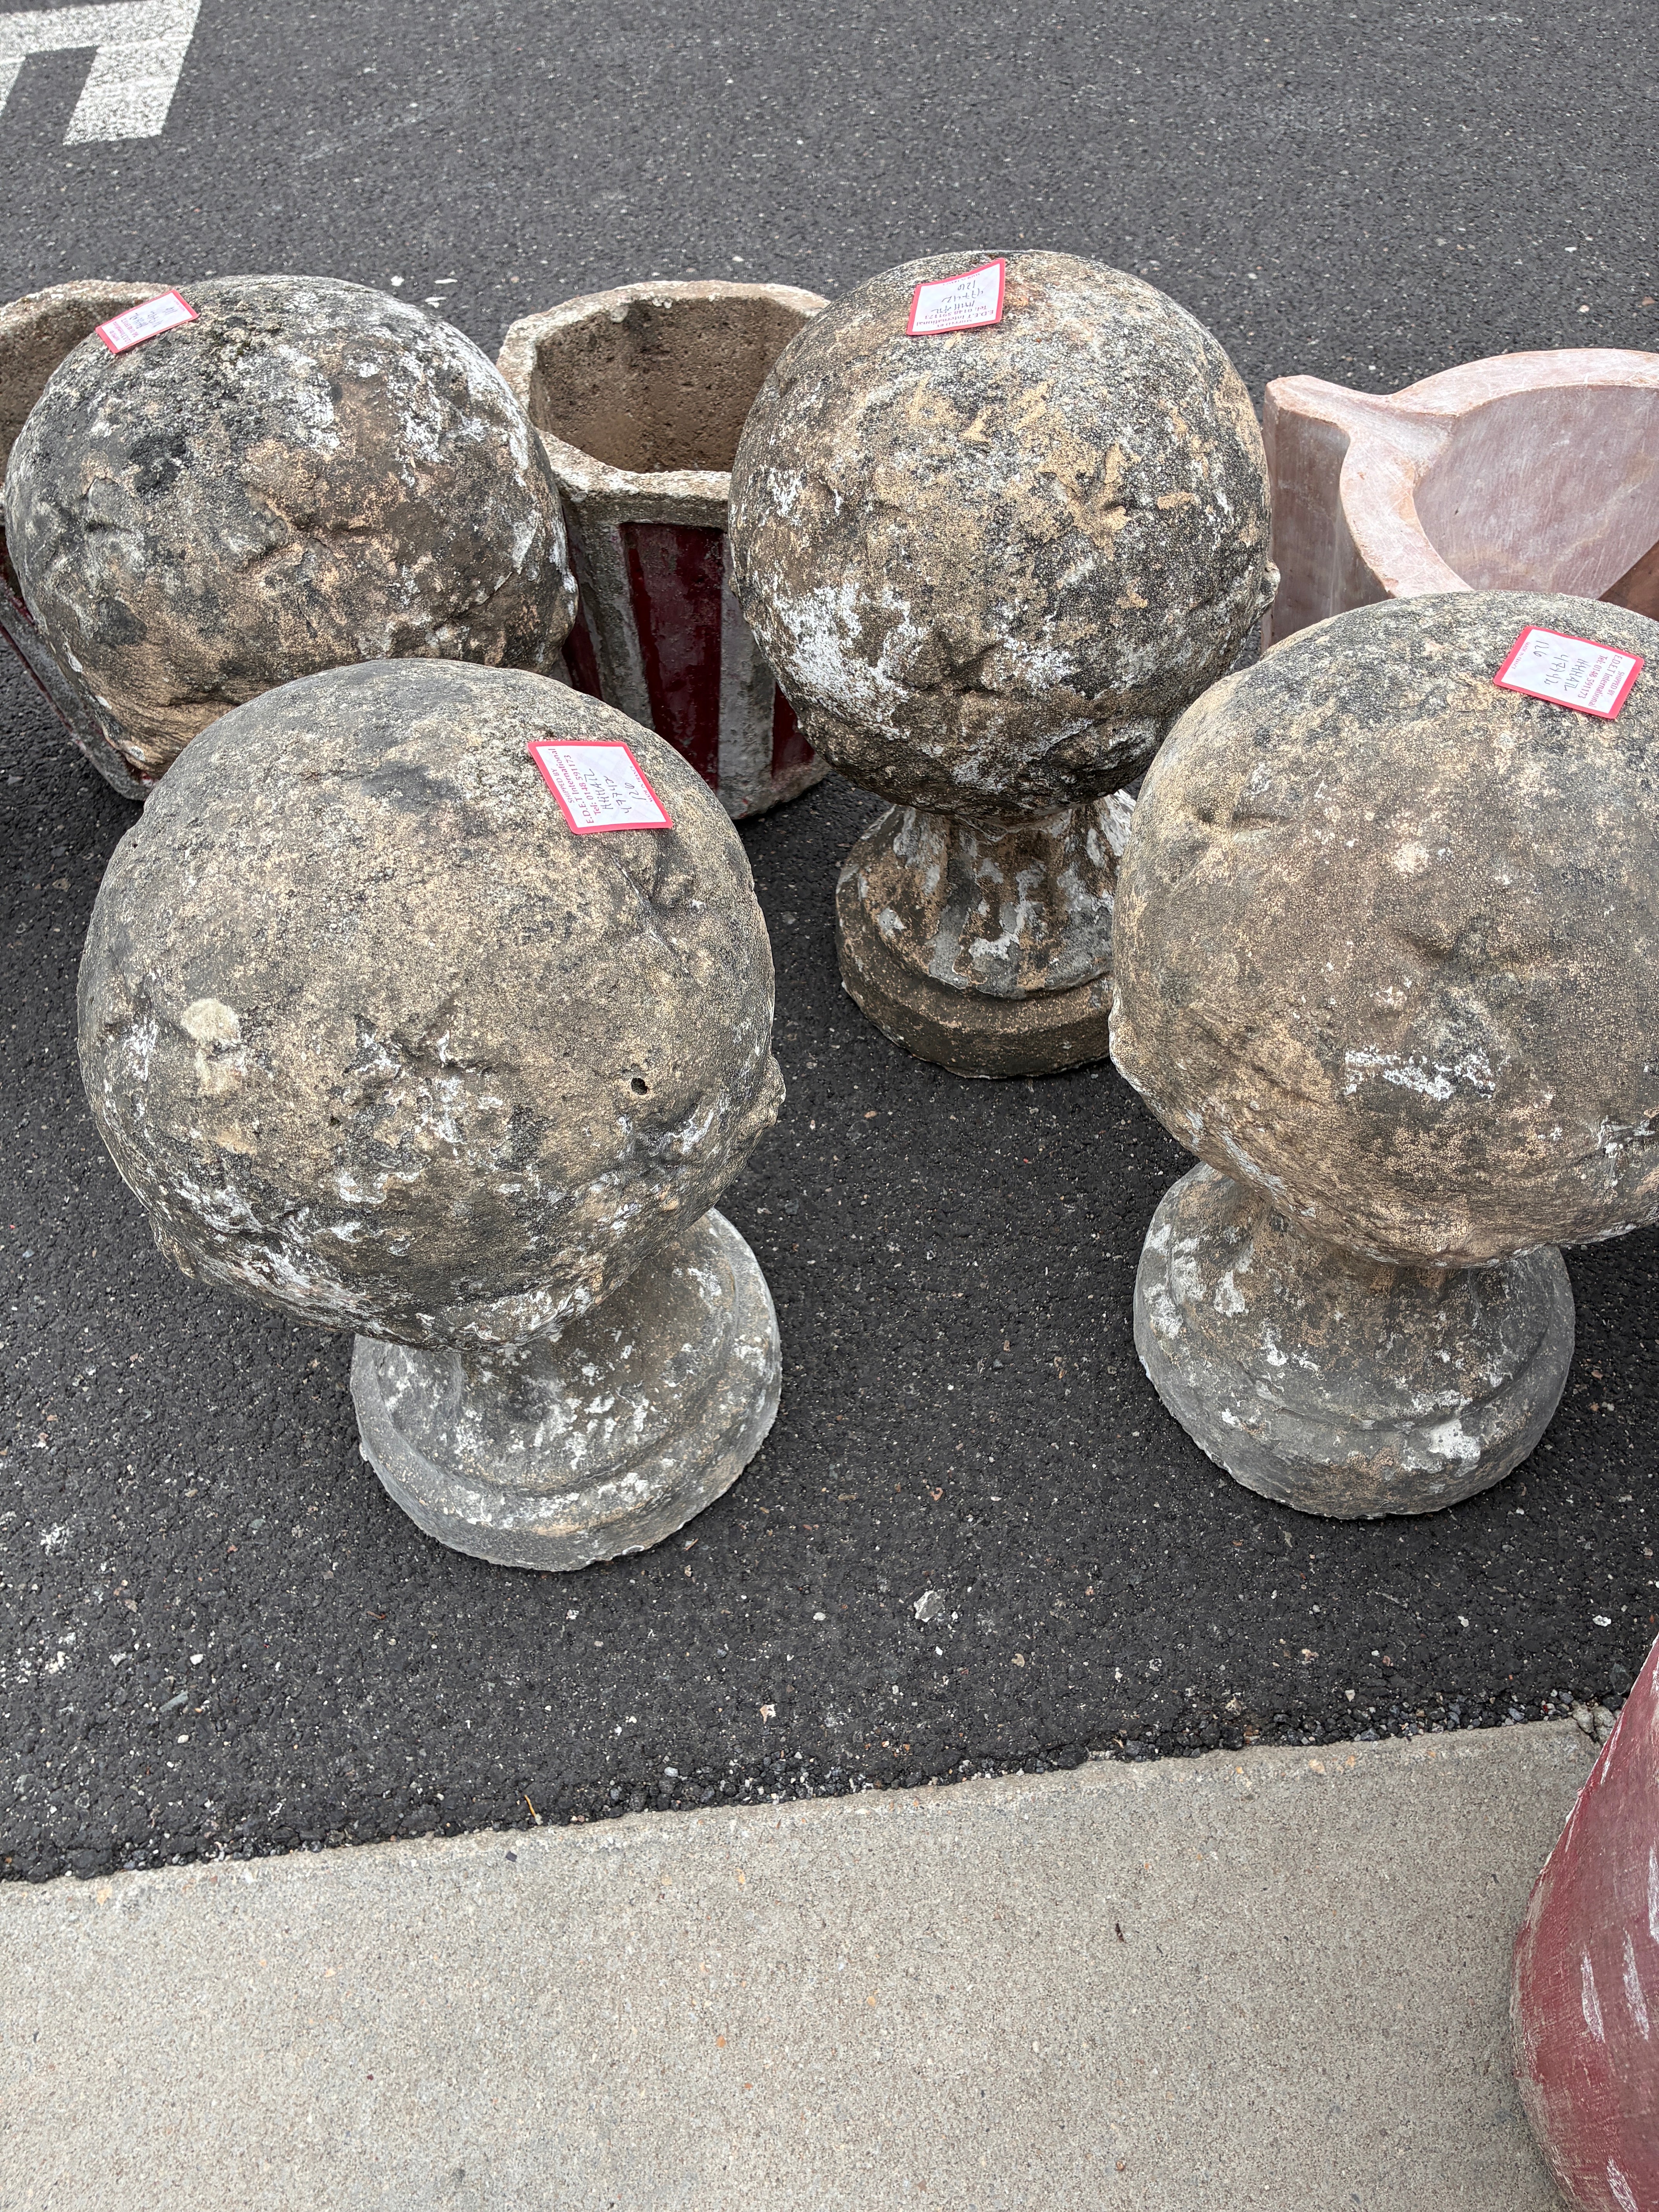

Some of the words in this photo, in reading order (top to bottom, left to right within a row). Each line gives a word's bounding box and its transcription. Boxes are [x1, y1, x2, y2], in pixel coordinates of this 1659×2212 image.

[1596, 656, 1607, 664] Tel:
[1589, 665, 1602, 677] 0148
[1611, 671, 1625, 689] SHIPPED
[1578, 678, 1594, 698] 591173
[1588, 673, 1613, 707] International
[548, 749, 579, 794] International
[564, 756, 583, 780] 591173
[556, 778, 574, 803] SHIPPED
[579, 783, 593, 800] 0148
[625, 783, 646, 800] 126
[575, 797, 594, 823] E.D.E.T
[590, 802, 601, 815] Tel:
